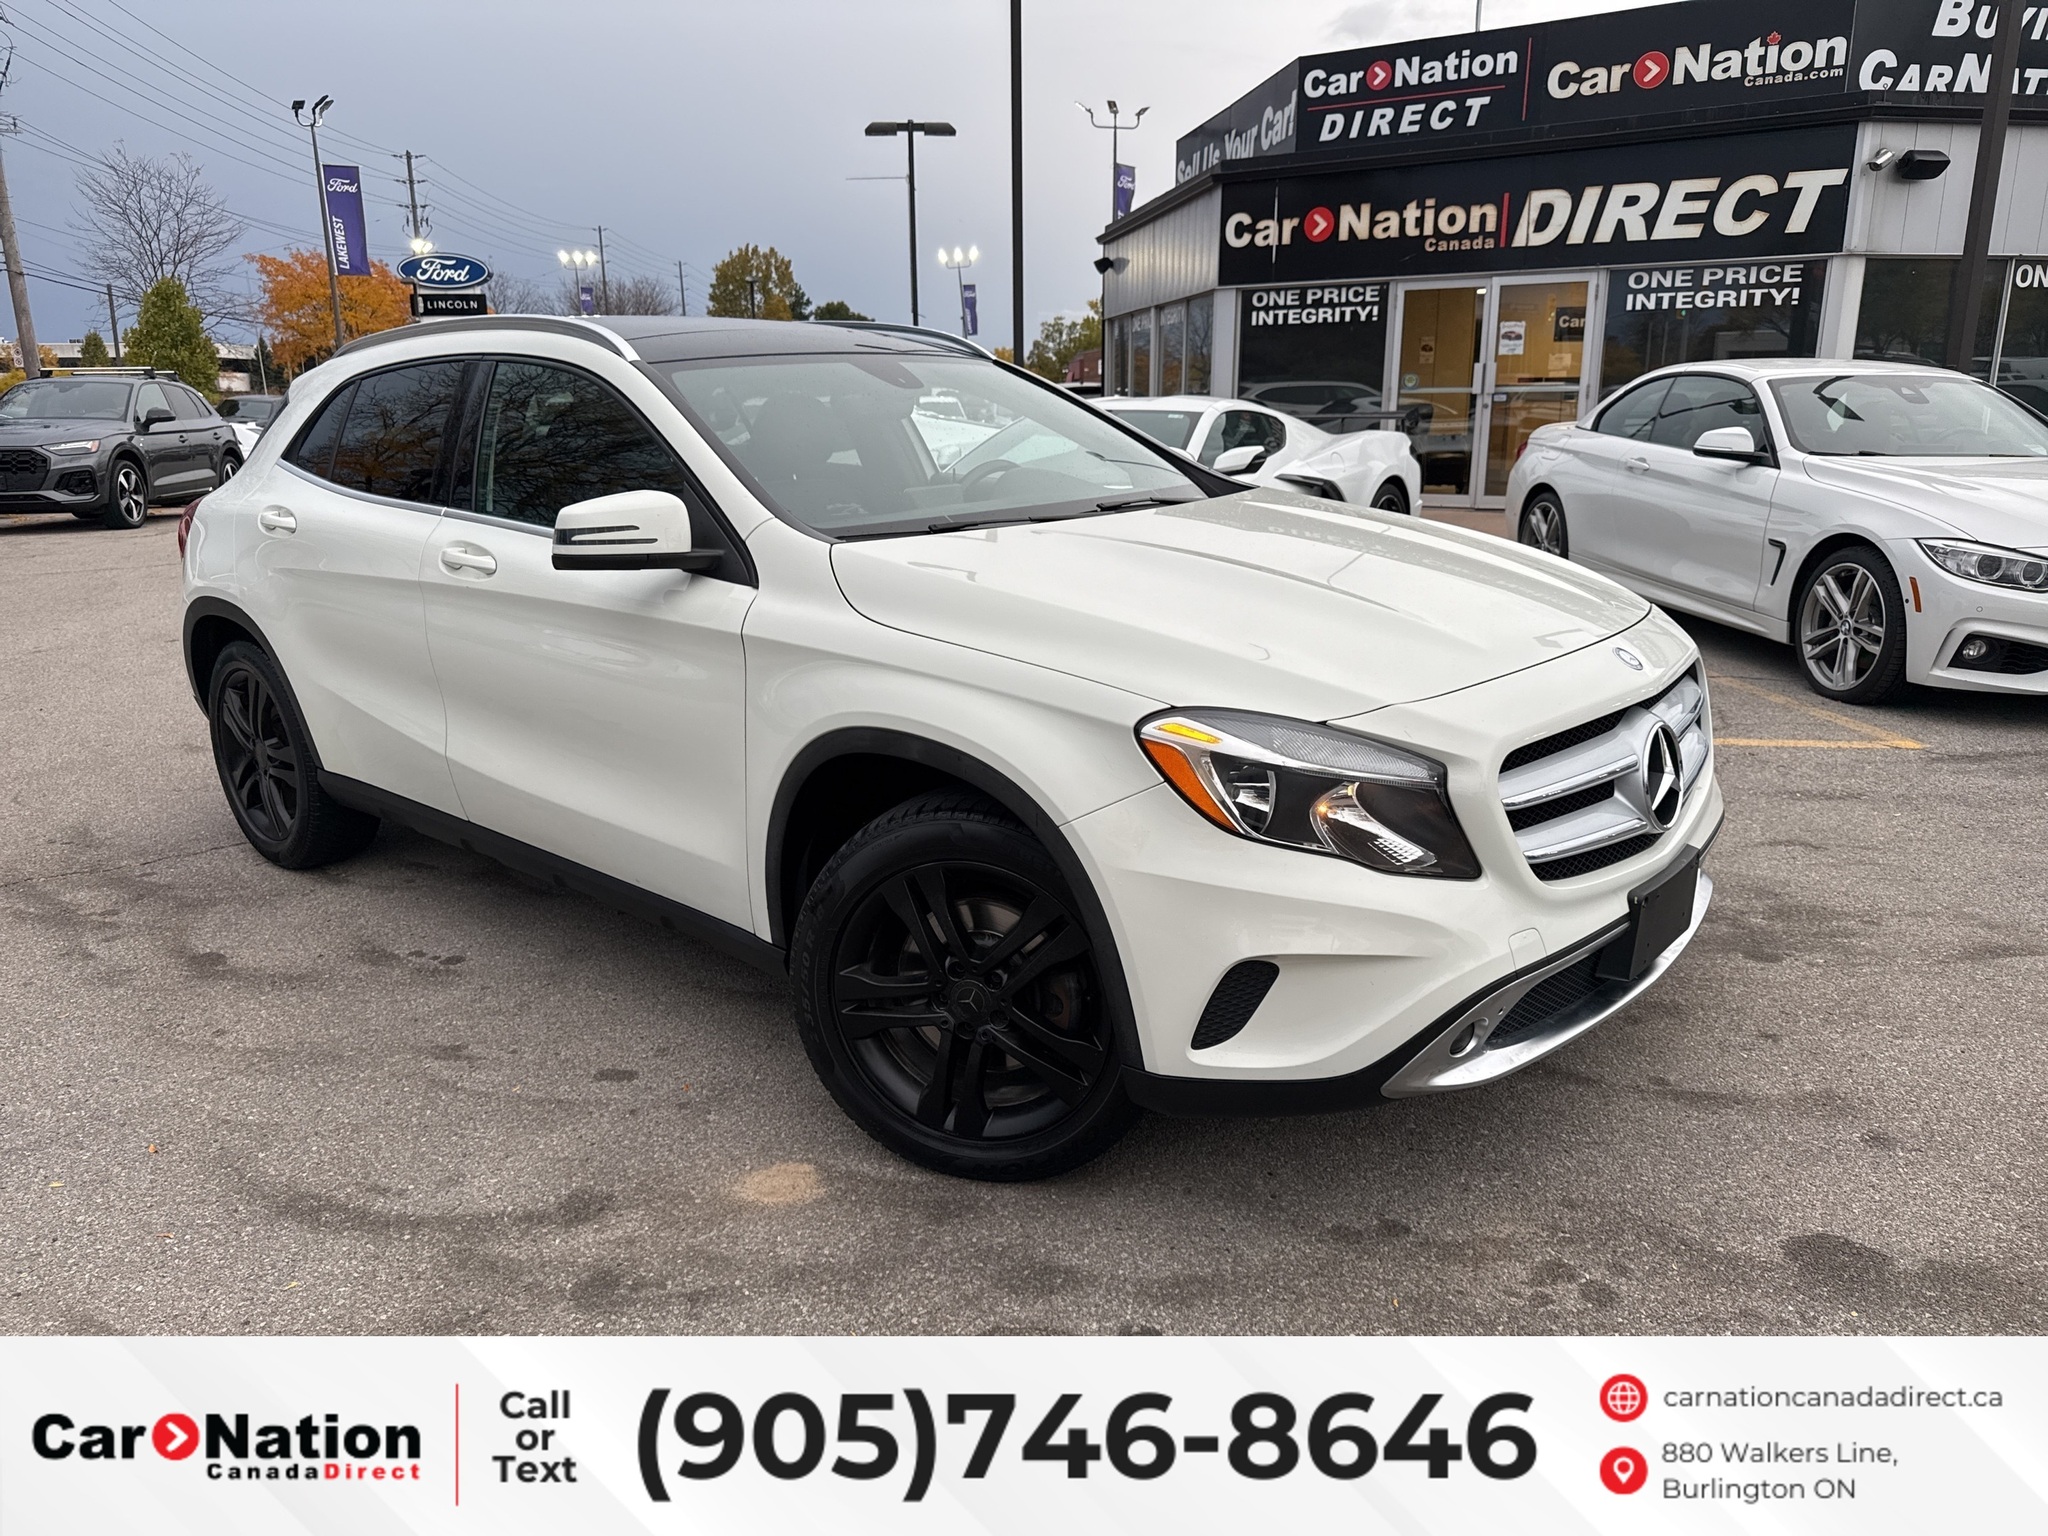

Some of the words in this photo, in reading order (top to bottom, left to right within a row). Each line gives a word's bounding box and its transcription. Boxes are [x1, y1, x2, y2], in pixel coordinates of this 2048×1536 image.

[1303, 69, 1365, 99] Car
[1393, 48, 1518, 88] Nation
[1546, 60, 1632, 100] Car
[1671, 34, 1848, 86] Nation
[1743, 67, 1844, 87] Canada.com
[1224, 124, 1258, 160] Your
[1260, 88, 1298, 151] Car!
[1318, 96, 1492, 142] DIRECT
[327, 177, 359, 193] Ford
[1511, 168, 1849, 248] DIRECT
[1224, 211, 1300, 248] Car
[1337, 198, 1498, 242] Nation
[332, 215, 350, 270] LAKEWEST
[1424, 235, 1495, 252] Canada
[416, 258, 472, 283] Ford
[1628, 269, 1694, 290] ONE
[1702, 264, 1804, 287] PRICE
[427, 300, 478, 310] LINCOLN
[1251, 289, 1301, 308] ONE
[1306, 285, 1381, 305] PRICE
[1625, 287, 1800, 312] INTEGRITY!
[1251, 305, 1379, 326] INTEGRITY!
